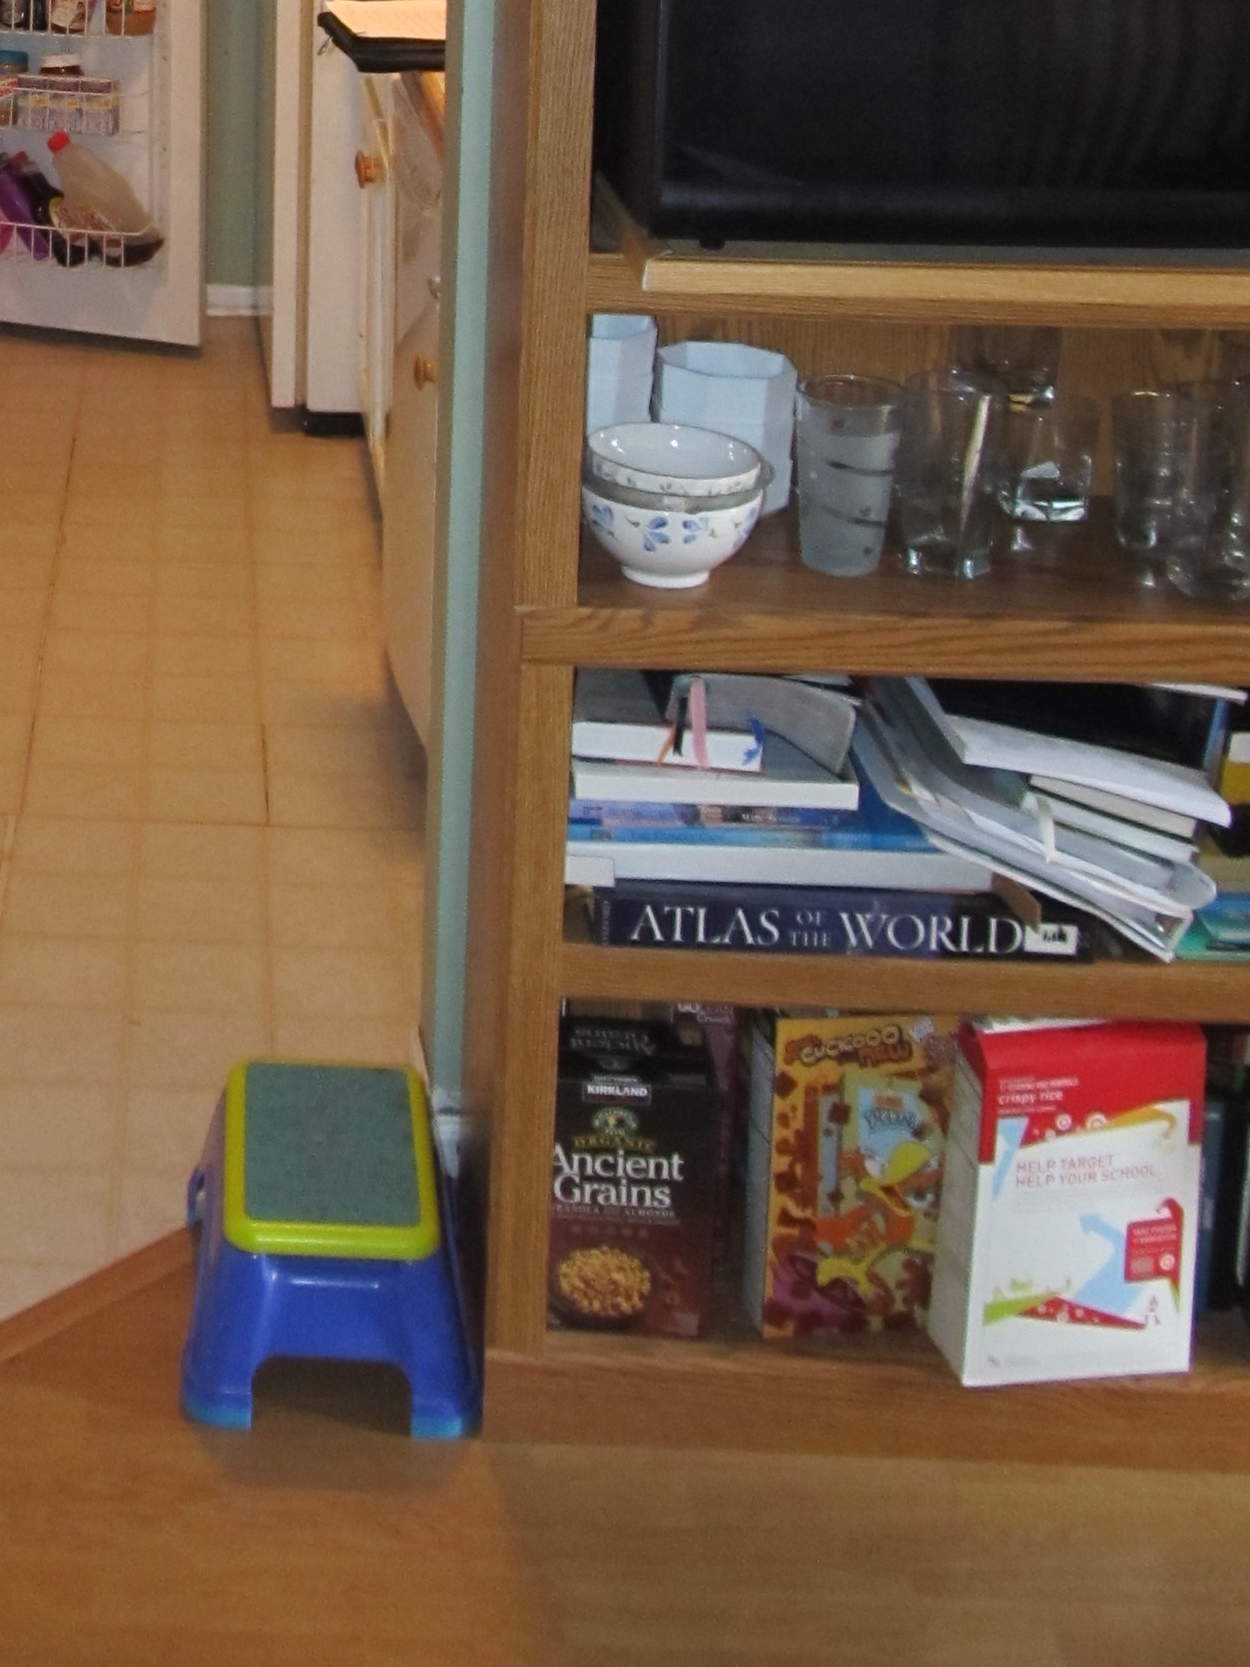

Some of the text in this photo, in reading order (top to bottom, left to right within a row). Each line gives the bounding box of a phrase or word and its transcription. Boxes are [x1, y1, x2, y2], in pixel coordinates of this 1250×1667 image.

[630, 904, 781, 946] ATLAS
[796, 909, 825, 926] OF
[789, 931, 832, 947] THE
[838, 911, 1023, 954] WORLD
[586, 1084, 649, 1097] KIRKLAND
[997, 1090, 1063, 1106] crispy rice
[554, 1142, 685, 1181] Ancient
[1016, 1154, 1114, 1174] HELP TARGET
[1015, 1172, 1056, 1188] HELP
[1059, 1171, 1098, 1185] YOUR
[553, 1171, 672, 1210] Grains
